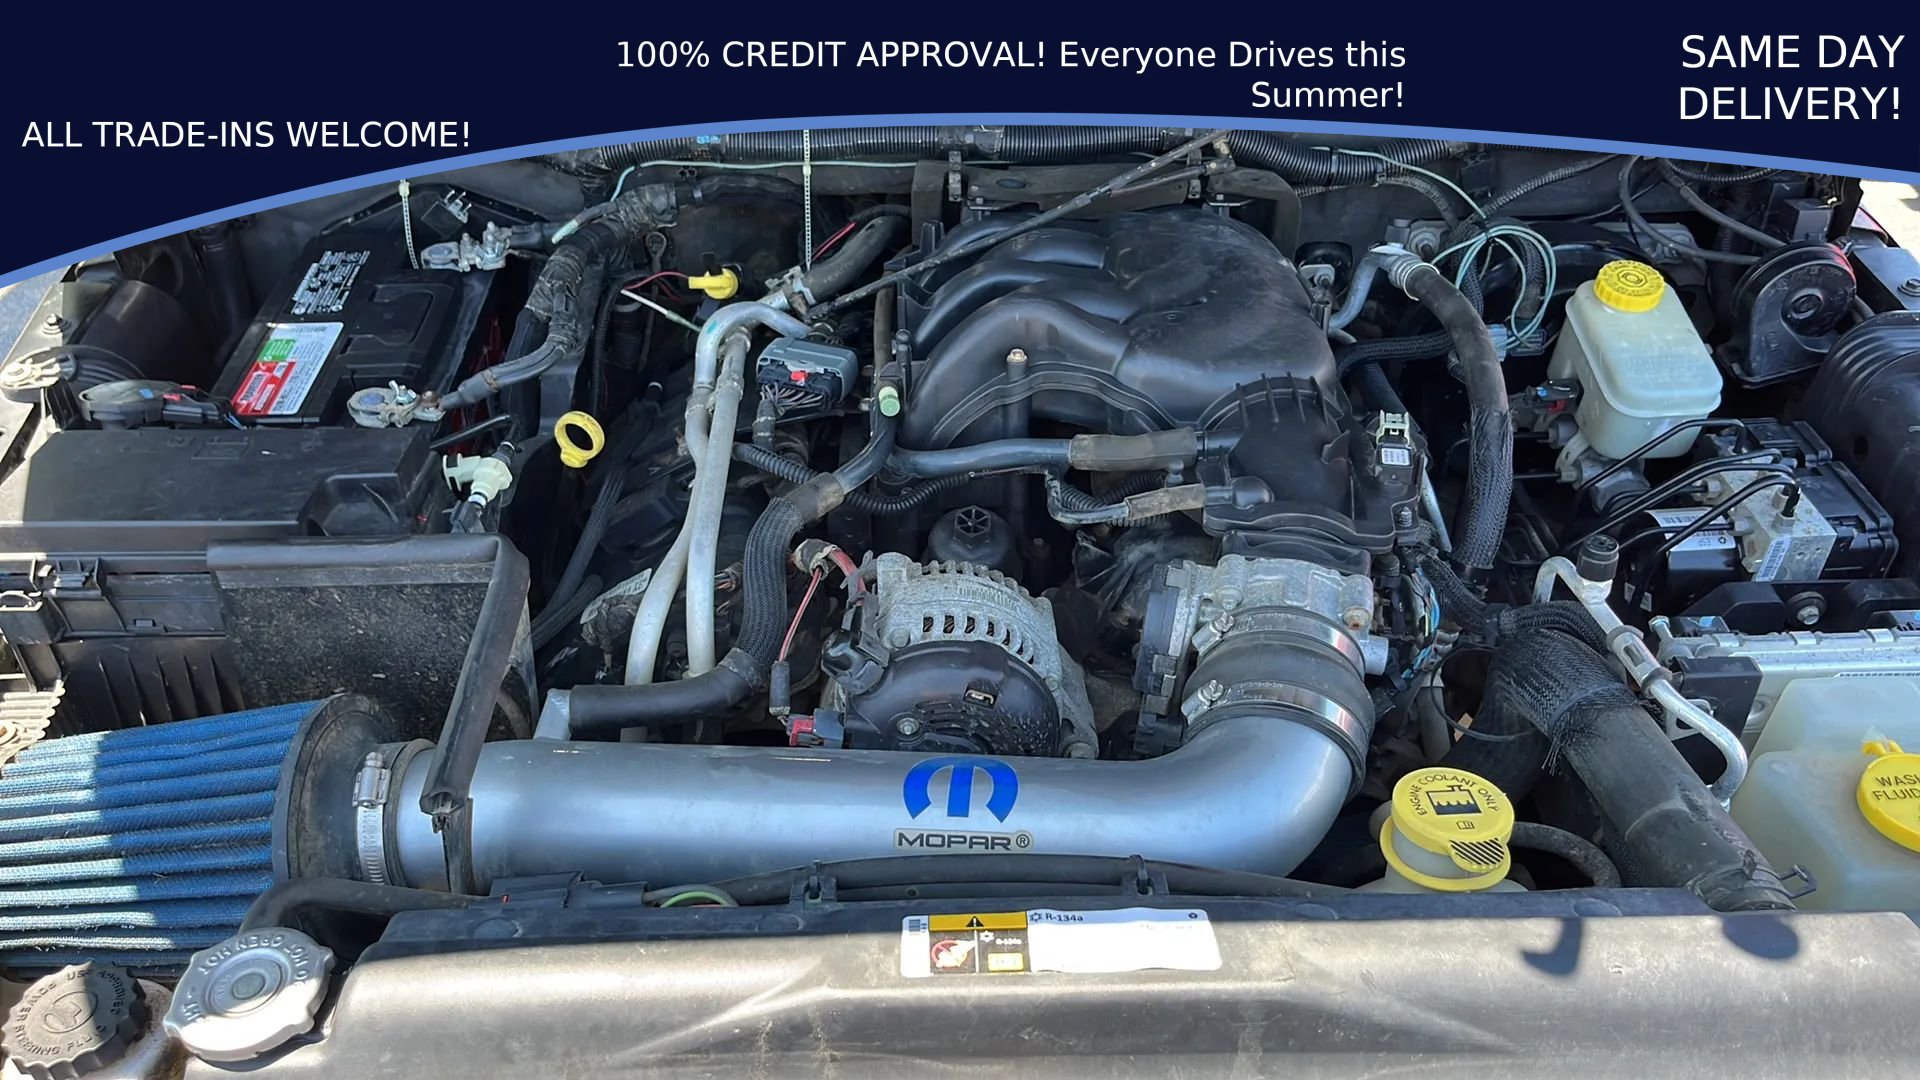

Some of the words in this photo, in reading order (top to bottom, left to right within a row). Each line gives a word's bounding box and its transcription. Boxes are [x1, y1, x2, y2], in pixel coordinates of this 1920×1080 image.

[1409, 785, 1427, 816] ENGINE
[1418, 774, 1478, 788] COOLANT
[1478, 788, 1500, 811] ONLY
[1045, 911, 1084, 922] R-134a
